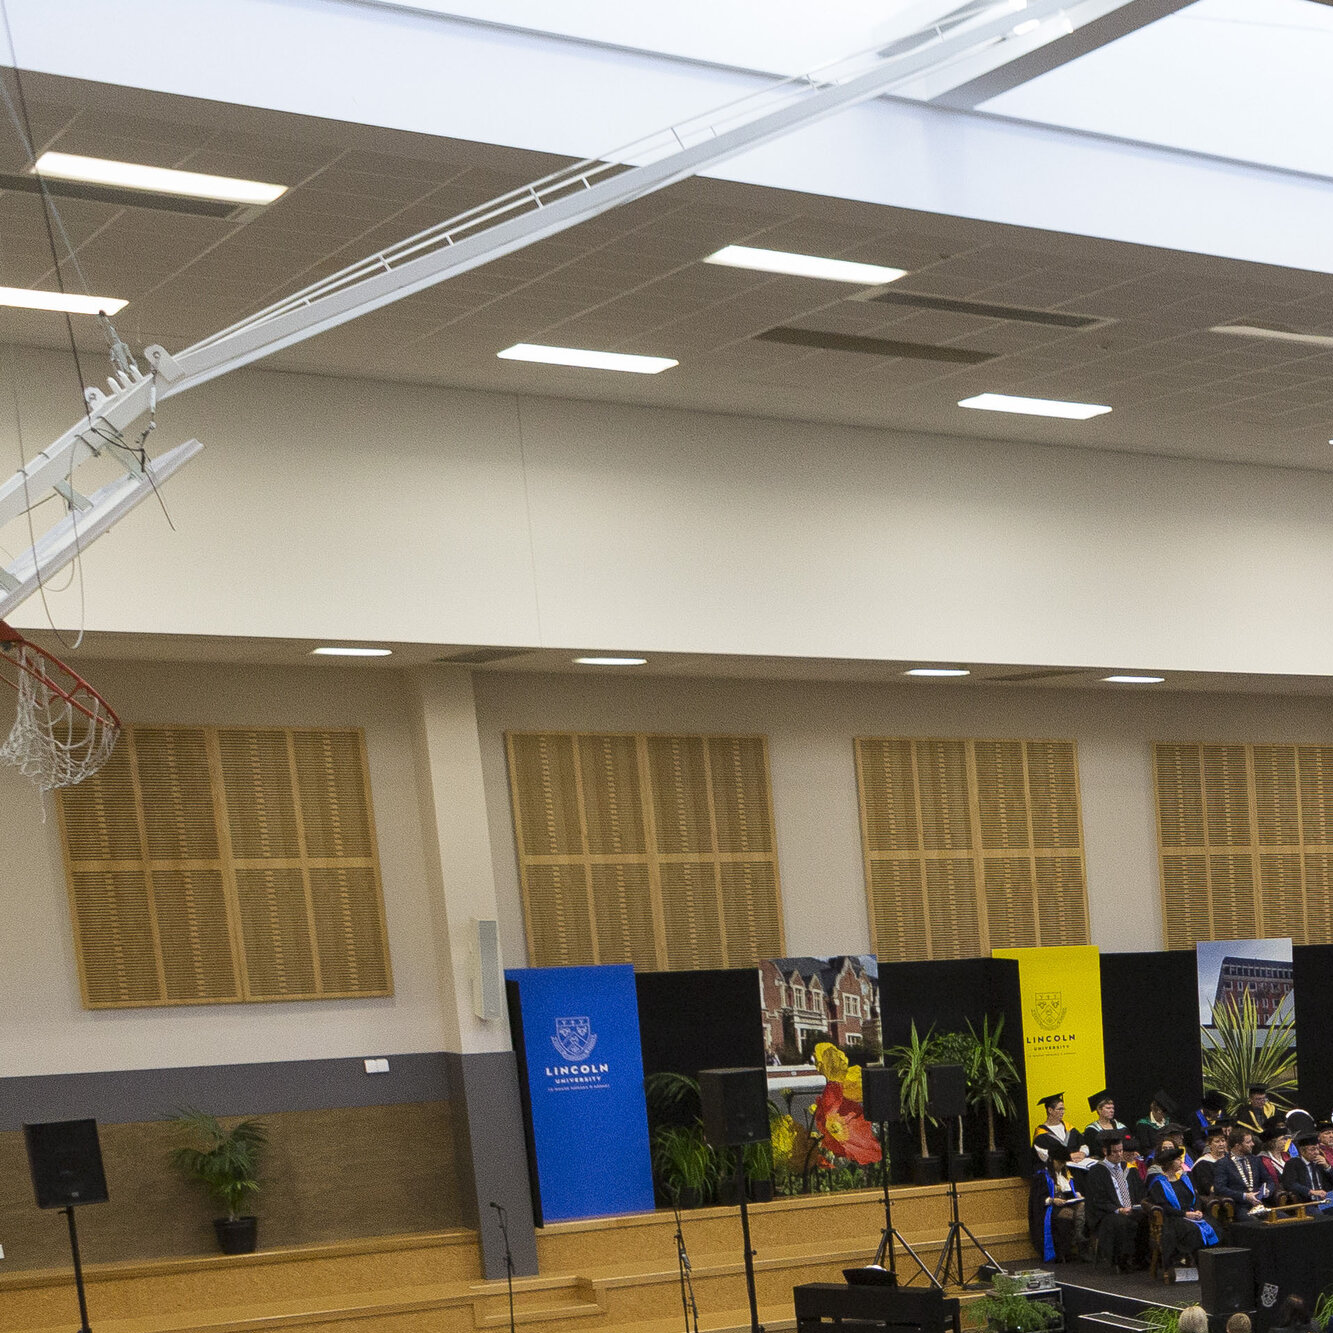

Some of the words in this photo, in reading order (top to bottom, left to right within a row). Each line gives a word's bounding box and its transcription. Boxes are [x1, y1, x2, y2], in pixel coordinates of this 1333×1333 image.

[1026, 1033, 1075, 1044] LINCOLN
[545, 1063, 609, 1076] LINCOLN
[554, 1075, 602, 1084] UNIVERSITY
